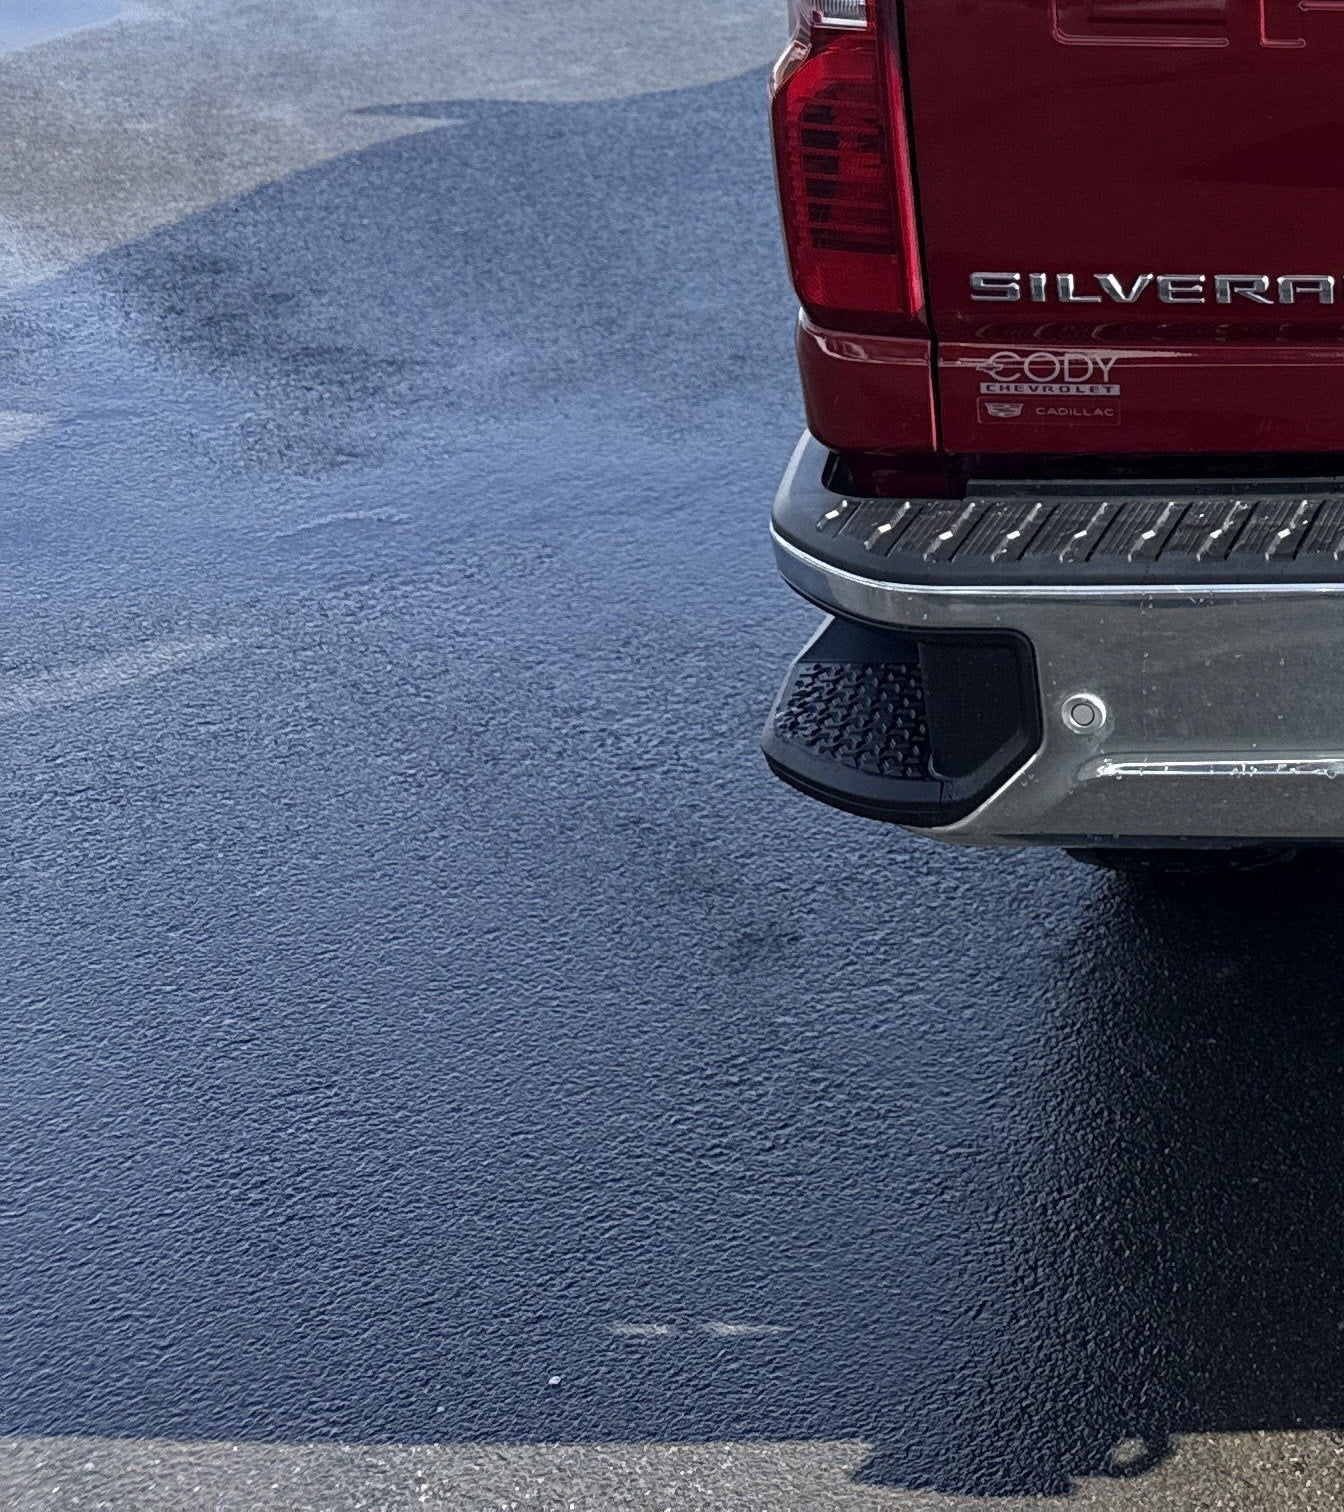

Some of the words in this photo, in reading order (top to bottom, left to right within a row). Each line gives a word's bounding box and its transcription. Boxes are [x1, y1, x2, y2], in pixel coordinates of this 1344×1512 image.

[978, 351, 1118, 383] CODY
[985, 384, 1116, 394] CHEVROLET
[1035, 406, 1115, 417] CADILLAC
